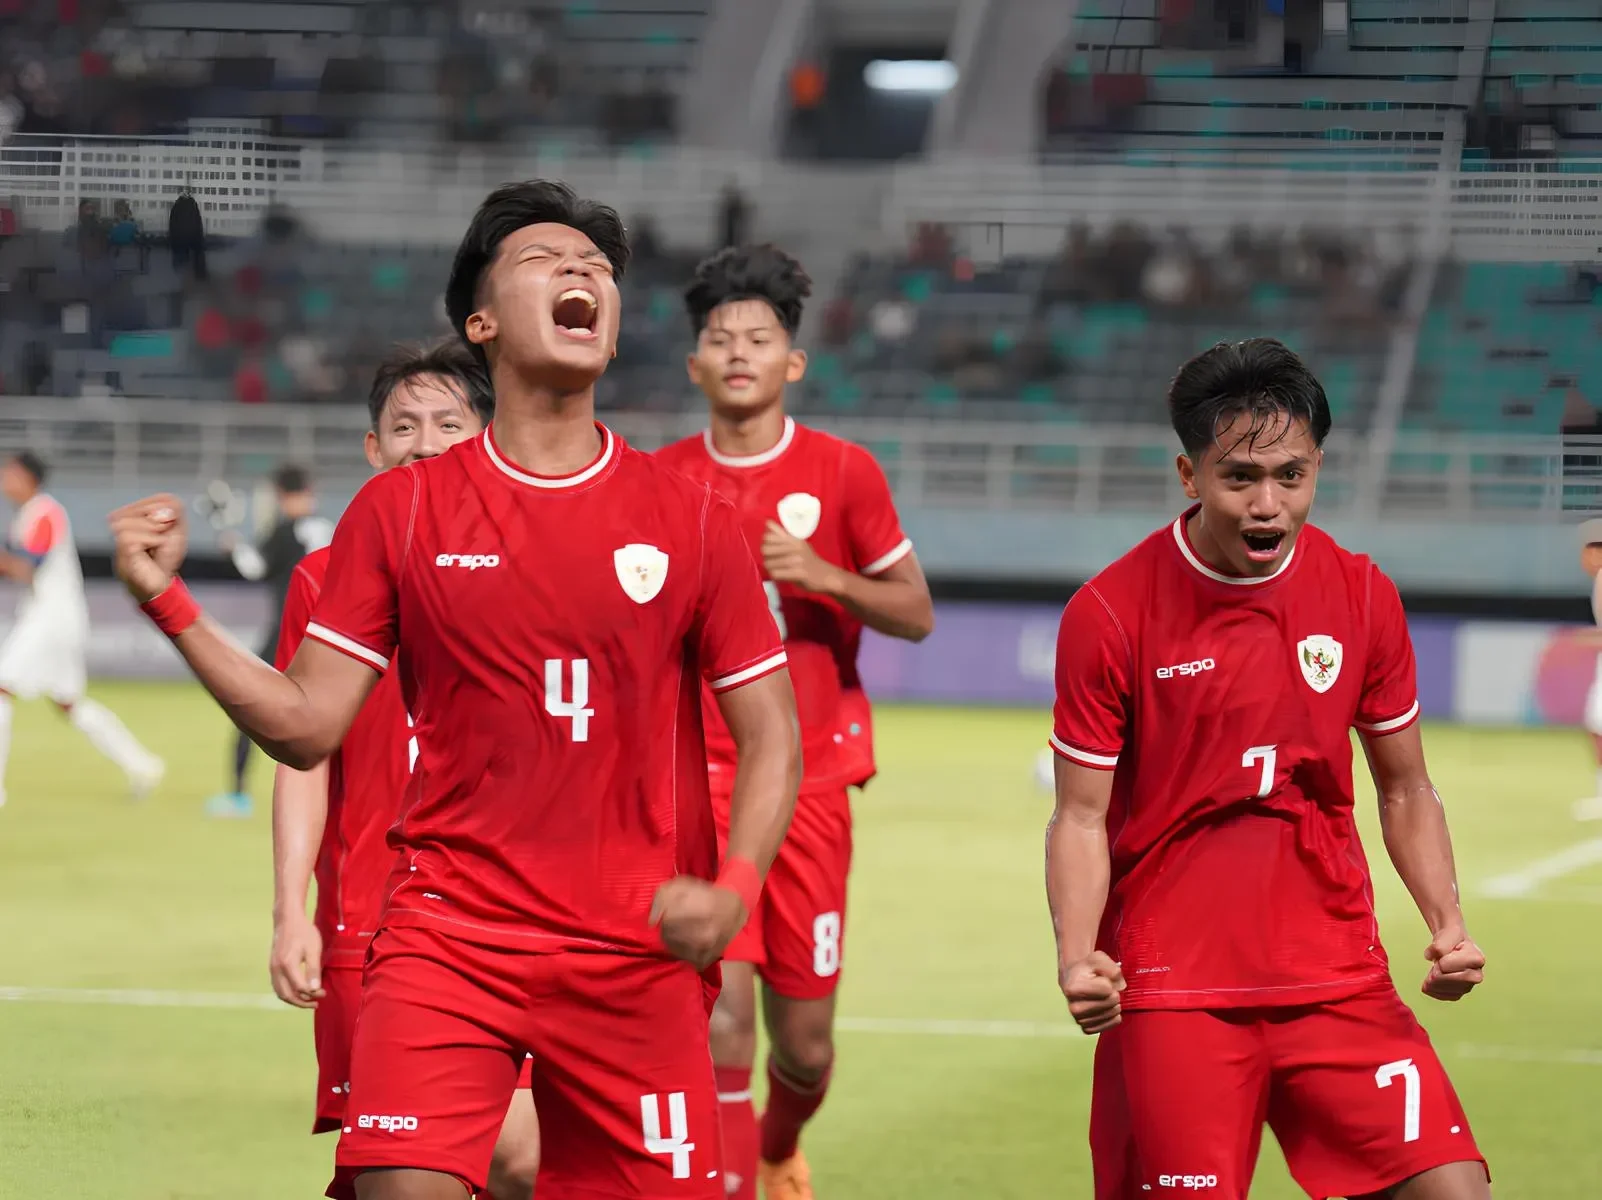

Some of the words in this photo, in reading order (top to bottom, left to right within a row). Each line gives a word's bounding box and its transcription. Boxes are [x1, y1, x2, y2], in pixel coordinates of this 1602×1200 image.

[436, 553, 500, 571] erspo
[1156, 657, 1216, 679] erspo
[544, 658, 595, 742] 4
[1241, 744, 1277, 797] 7
[812, 912, 841, 978] 8
[358, 1113, 418, 1133] erspo
[1374, 1058, 1421, 1143] 7
[640, 1092, 695, 1179] 4
[1158, 1174, 1218, 1191] erspo
